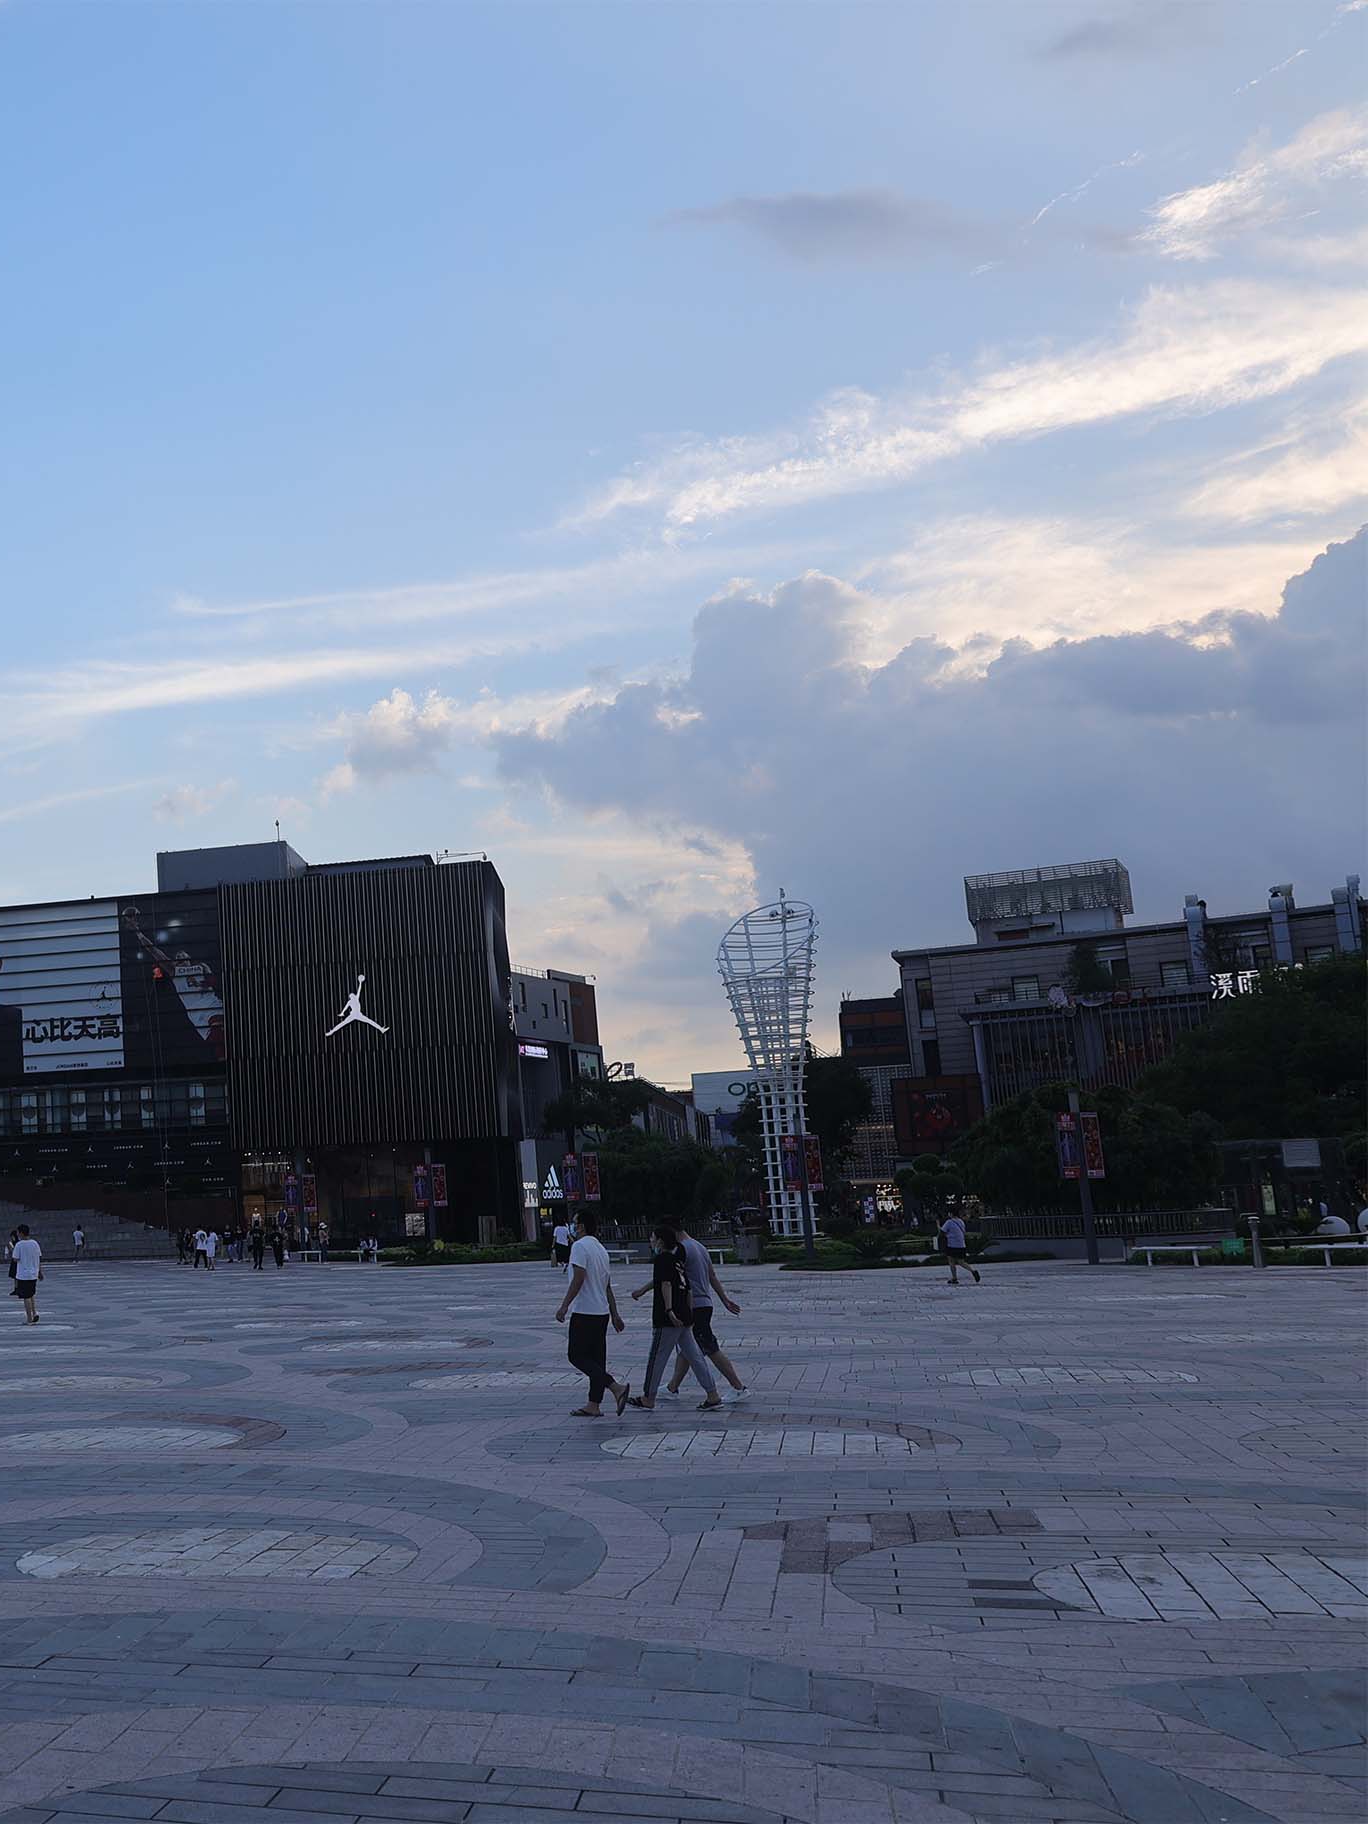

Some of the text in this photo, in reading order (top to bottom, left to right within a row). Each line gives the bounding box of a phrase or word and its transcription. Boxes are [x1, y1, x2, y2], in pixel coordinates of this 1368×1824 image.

[25, 1013, 120, 1043] 心比天高
[542, 1186, 564, 1200] adidas
